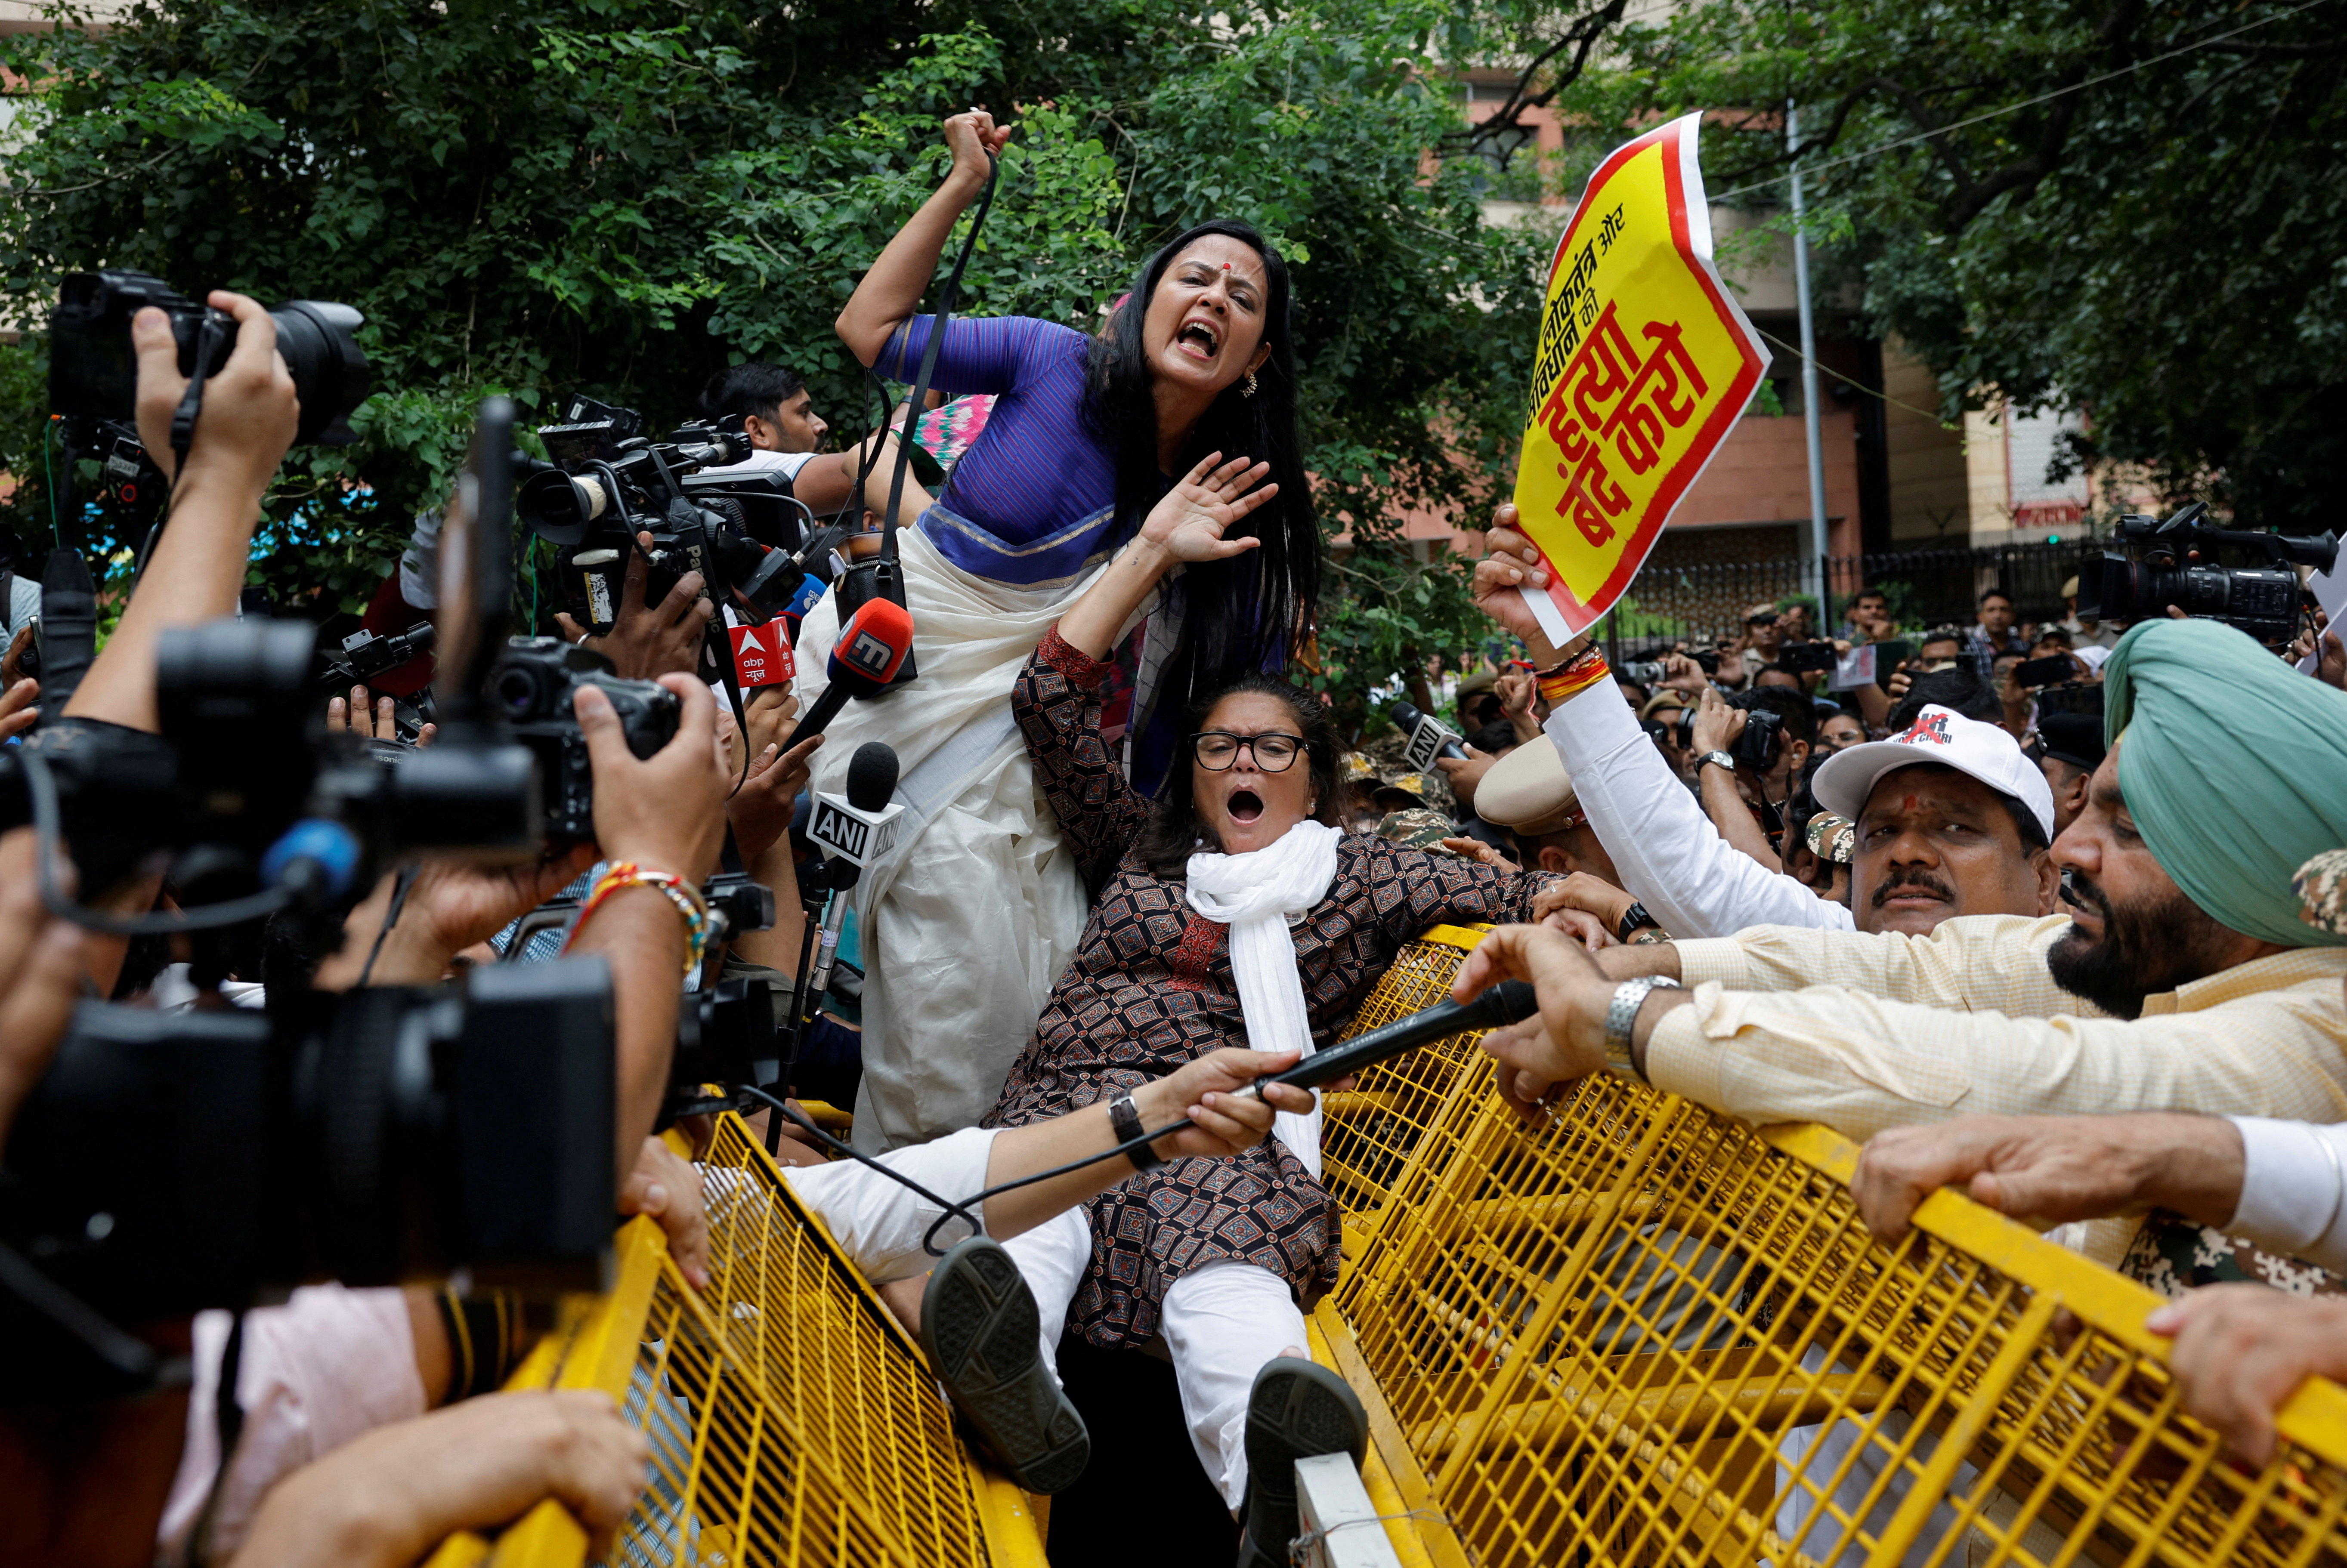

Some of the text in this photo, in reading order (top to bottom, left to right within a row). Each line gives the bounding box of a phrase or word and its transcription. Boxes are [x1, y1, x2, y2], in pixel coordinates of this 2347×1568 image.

[1542, 202, 1625, 354] लोकतंत्र और
[1527, 286, 1599, 430] संविधान की
[1537, 298, 1642, 463] हत्या
[1555, 319, 1709, 547] बंद करो
[686, 545, 720, 633] Pasic
[743, 658, 764, 667] abp
[745, 670, 765, 682] न्यूज़
[374, 755, 402, 764] asonic
[1413, 726, 1438, 765] ANI
[816, 809, 865, 855] ANI
[873, 818, 900, 857] ANI
